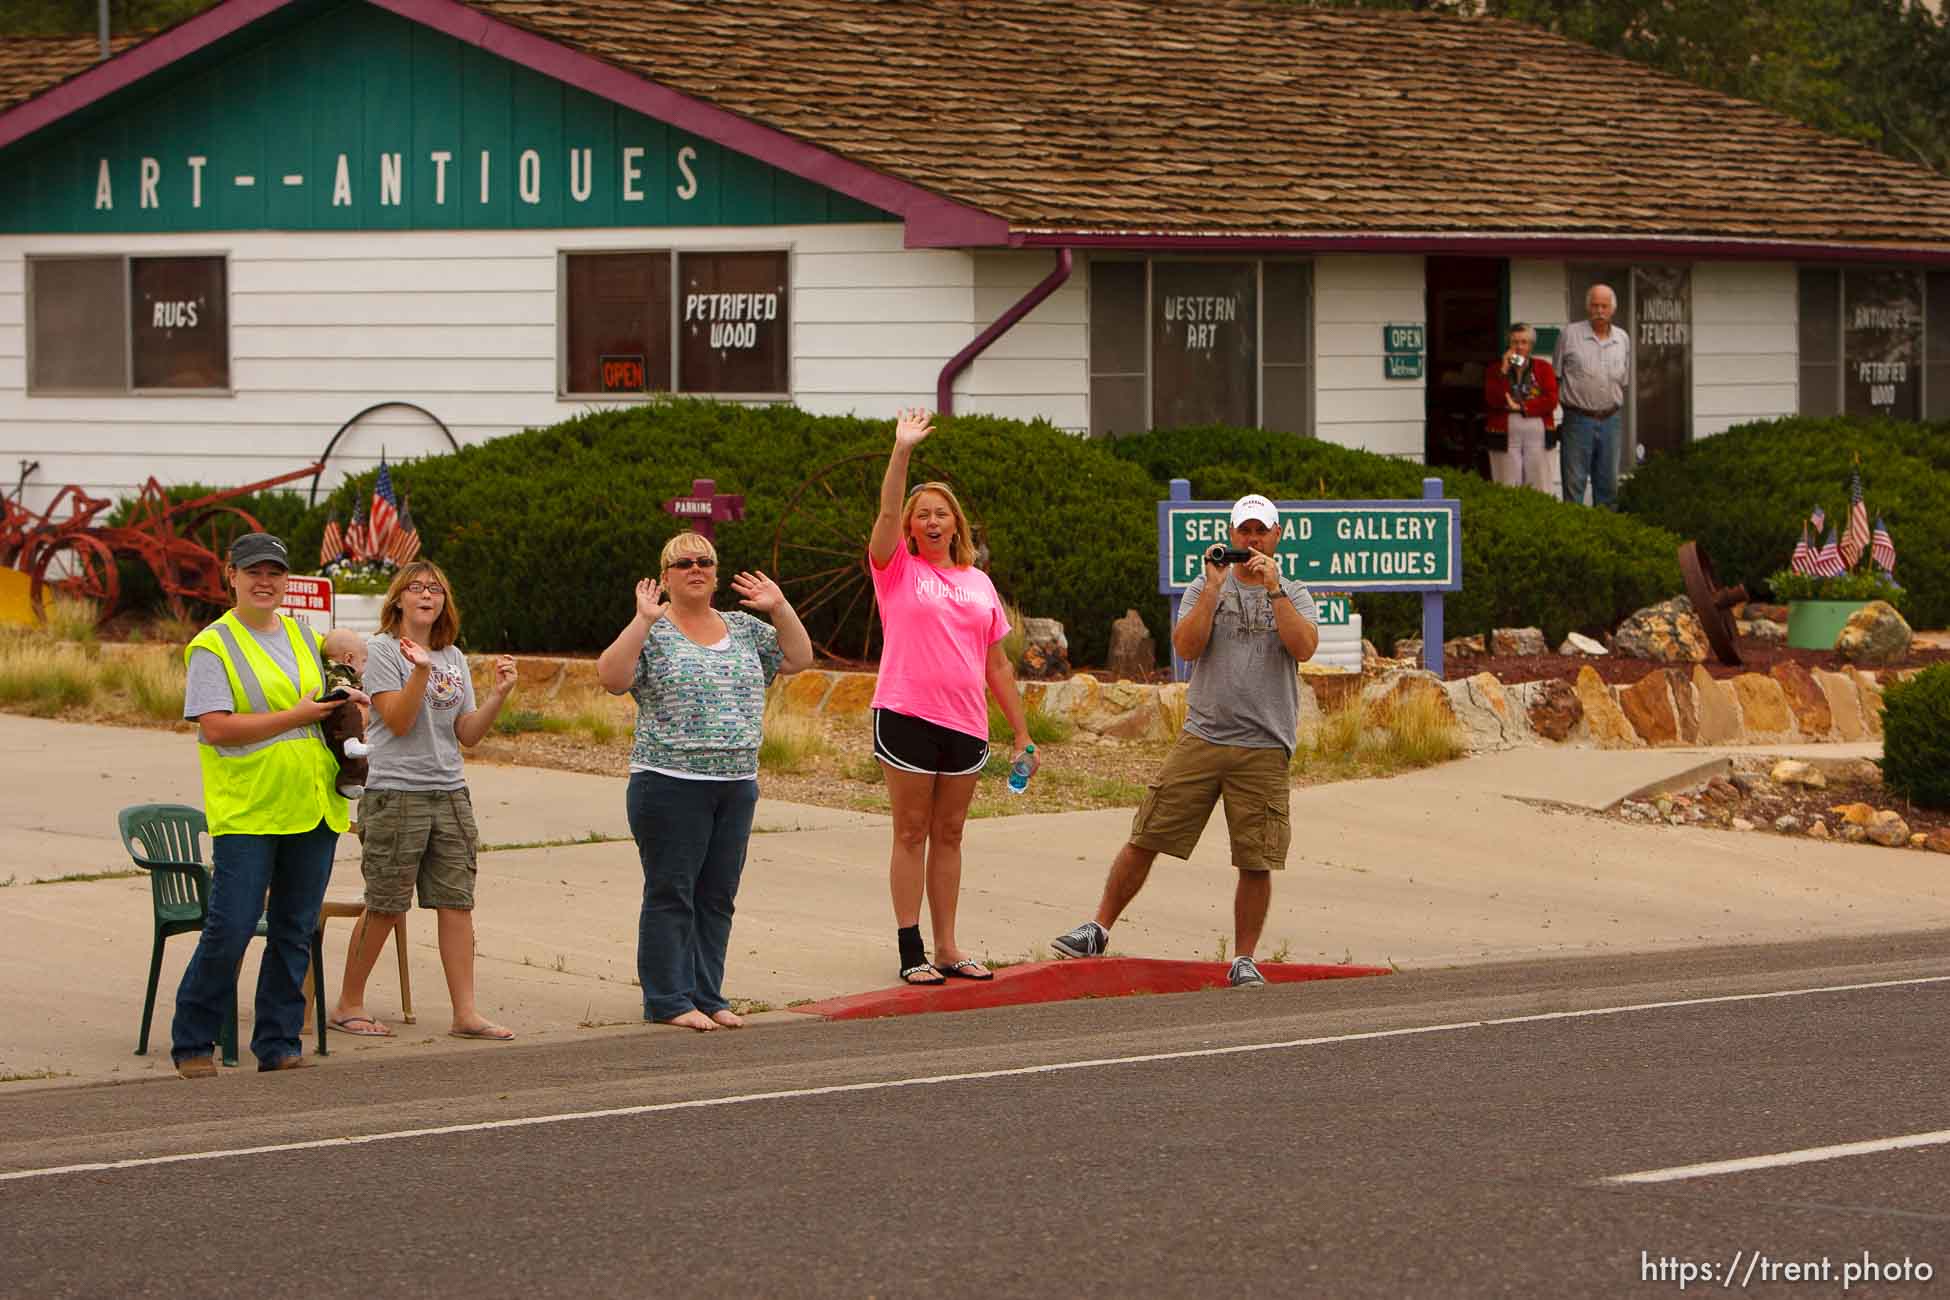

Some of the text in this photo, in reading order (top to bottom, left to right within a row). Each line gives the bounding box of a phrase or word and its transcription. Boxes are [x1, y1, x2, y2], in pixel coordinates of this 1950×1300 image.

[152, 300, 199, 328] RUGS
[685, 293, 777, 321] PETRIFIED
[1165, 296, 1236, 321] WESTERN
[710, 322, 756, 348] WOOD
[1187, 324, 1217, 349] ART
[1392, 328, 1421, 348] OPEN
[603, 361, 643, 388] OPEN
[674, 501, 712, 514] PARKING
[1337, 517, 1437, 540] GALLERY
[1330, 551, 1437, 576] ANTIQUES
[308, 596, 324, 609] FOR
